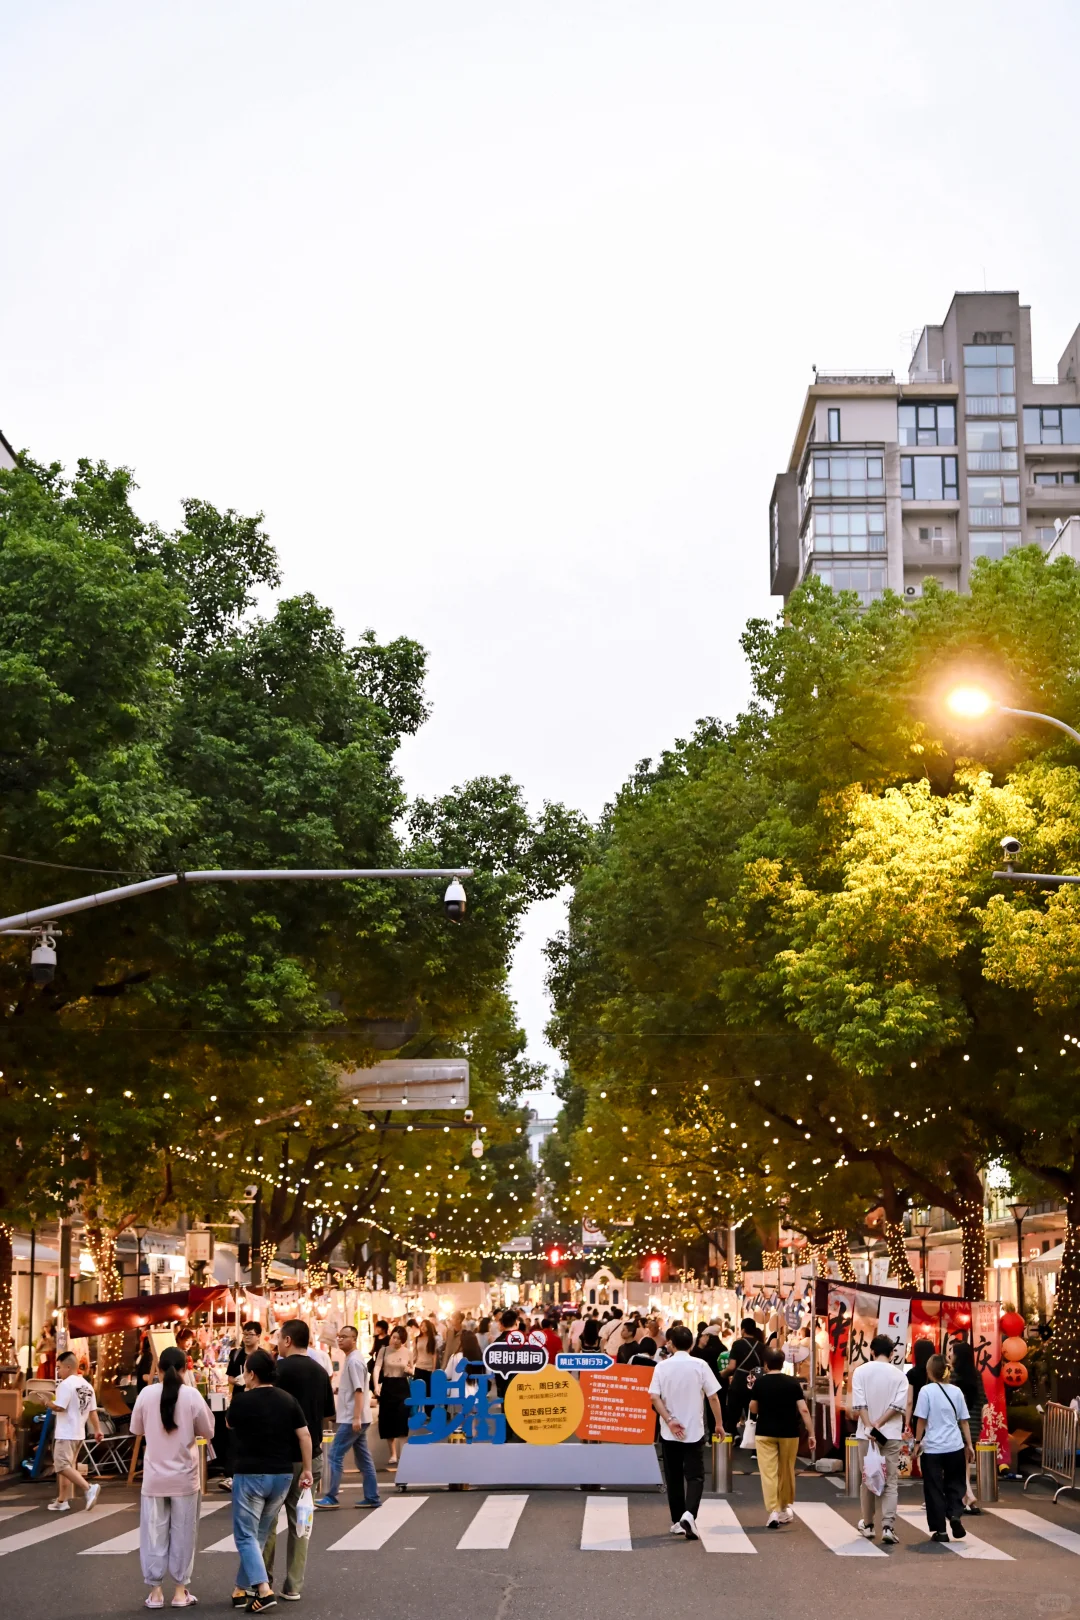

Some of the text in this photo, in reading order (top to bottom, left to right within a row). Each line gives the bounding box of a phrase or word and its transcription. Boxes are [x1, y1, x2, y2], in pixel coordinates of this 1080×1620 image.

[941, 1302, 971, 1310] CHINA
[488, 1350, 543, 1365] 限时期间
[974, 1335, 1003, 1377] 庆
[1005, 1367, 1023, 1375] 中秋
[516, 1381, 569, 1391] 周六、周日全天
[521, 1406, 567, 1416] 国定假日全天
